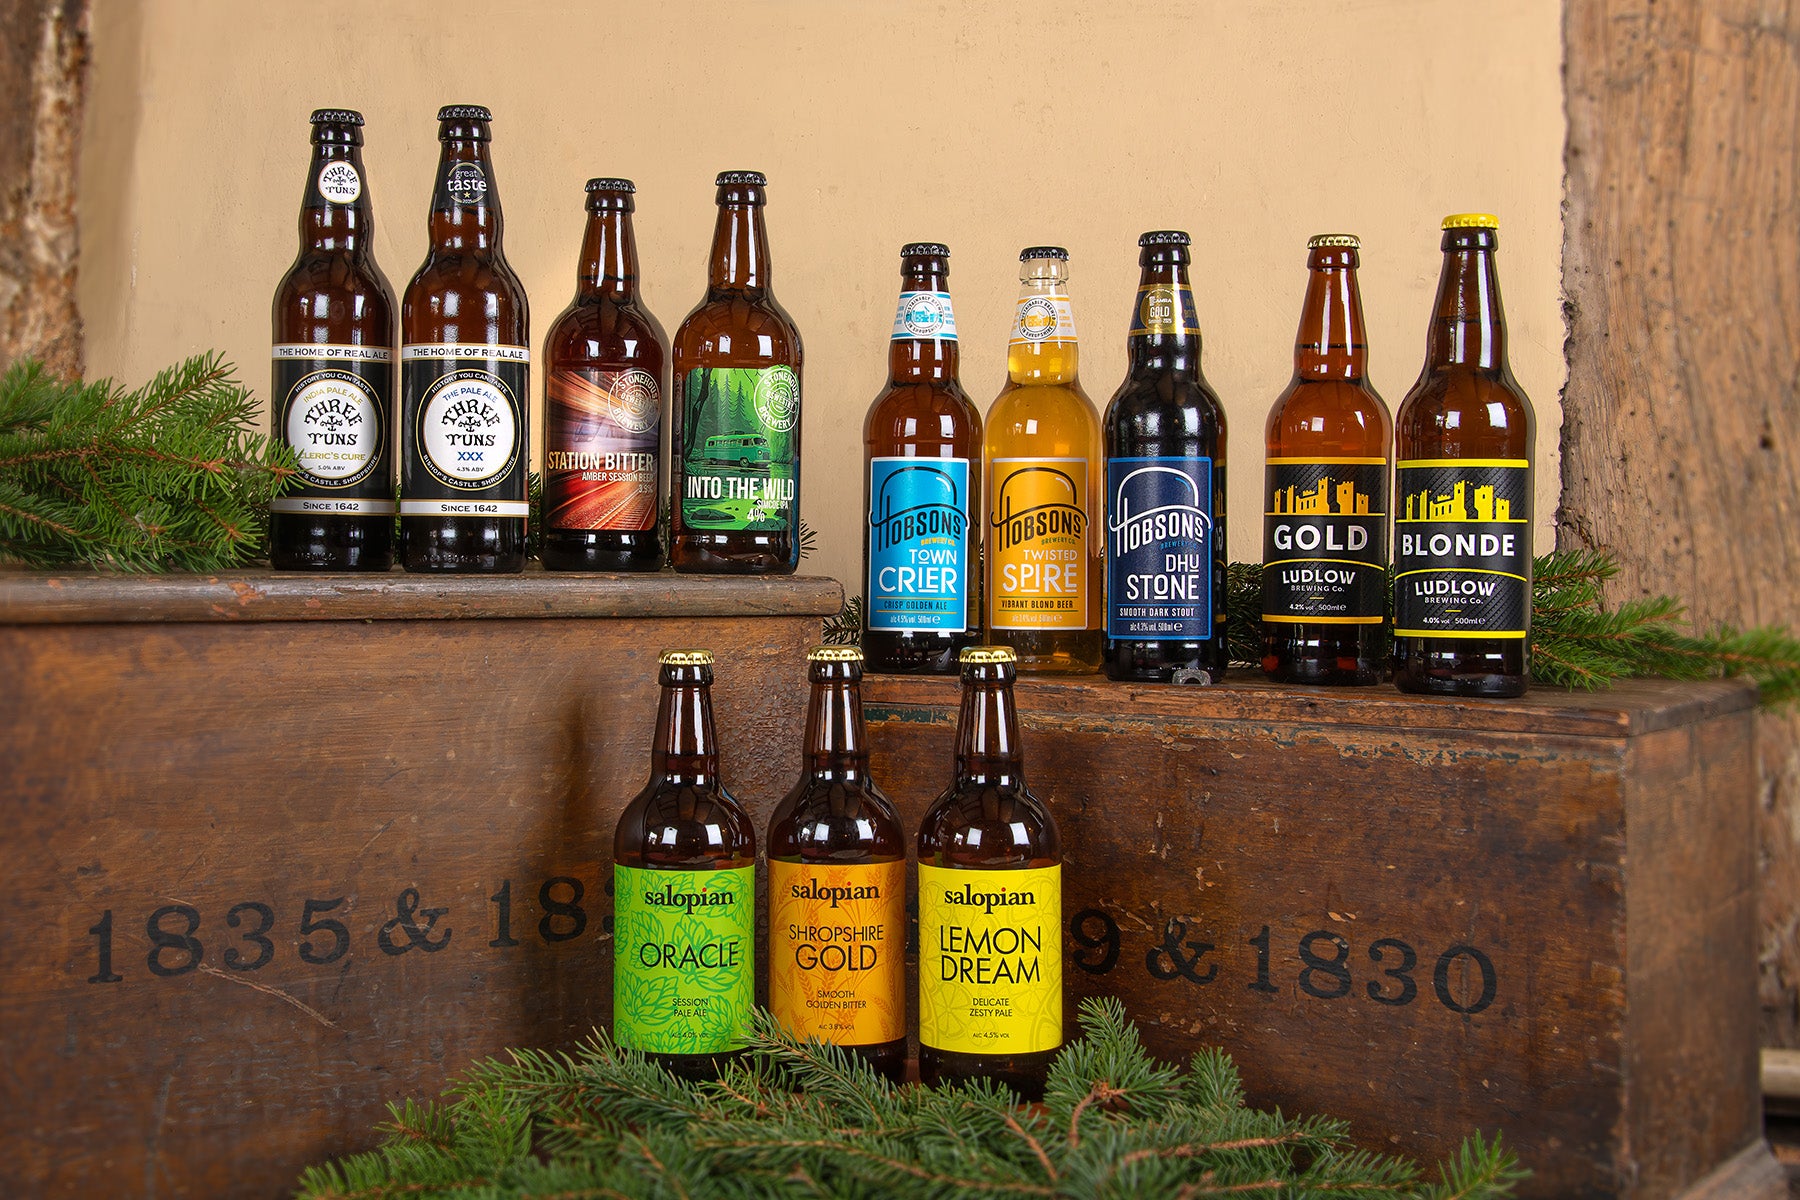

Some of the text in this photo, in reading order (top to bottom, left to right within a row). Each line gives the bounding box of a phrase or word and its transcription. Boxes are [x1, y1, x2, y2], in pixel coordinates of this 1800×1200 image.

[323, 166, 358, 184] THREE
[455, 170, 478, 180] great
[325, 186, 356, 195] TUNS
[447, 178, 487, 192] taste
[1150, 306, 1170, 317] GOLD
[279, 348, 388, 360] THE HOME OF REAL ALE
[413, 348, 523, 360] THE HOME OF REAL ALE
[295, 374, 321, 393] HISTORY
[337, 373, 354, 382] CAN
[353, 378, 371, 394] TASTE
[431, 373, 458, 394] HISTORY
[474, 373, 490, 382] CAN
[490, 378, 508, 395] TASTE
[618, 373, 659, 405] STONEHOUSE
[764, 371, 799, 402] STONEHOUSE
[303, 387, 364, 404] INDIA PALE ALE
[443, 387, 498, 404] THE PALE ALE
[304, 398, 363, 427] THREE
[441, 398, 501, 428] THREE
[613, 407, 650, 430] BREWERY
[759, 405, 791, 429] BREWERY
[308, 432, 359, 446] TUNS
[445, 433, 497, 447] TUNS
[340, 453, 366, 461] CURE
[457, 452, 484, 461] XXX
[548, 451, 654, 472] STATION BITTER
[342, 455, 378, 485] SHROPSHIRE
[423, 454, 447, 481] BISHOP'S
[481, 456, 516, 486] SHROPSHIRE
[582, 471, 654, 483] AMBER SESSION BEER
[687, 476, 794, 501] INTO THE WILD
[303, 501, 360, 511] SINCE 1642
[441, 504, 498, 512] SINCE 1642
[746, 508, 766, 523] 4%
[1274, 524, 1369, 551] GOLD
[1402, 533, 1516, 557] BLONDE
[908, 549, 958, 565] TOWN
[1023, 549, 1078, 561] TWISTED
[879, 566, 958, 594] CRIER
[1002, 563, 1078, 593] SPIRE
[1282, 569, 1356, 585] LUDLOW
[1126, 574, 1200, 601] STONE
[1415, 579, 1496, 597] LUDLOW
[884, 600, 948, 610] CRISP GOLDEN ALE
[1002, 600, 1073, 609] VIBRANT BLOND BEER
[1289, 603, 1304, 611] 4.2%
[1424, 596, 1467, 604] BREWING
[1119, 608, 1195, 618] SMOOTH DARK STOUT
[1423, 616, 1440, 624] 4.0%
[1454, 617, 1478, 625] 500ml
[644, 885, 734, 915] salopian
[791, 878, 881, 909] salopian
[944, 883, 1036, 915] salopian
[87, 896, 352, 985] 1835
[377, 887, 453, 957] &
[789, 924, 884, 943] SHROPSHIRE
[940, 925, 1042, 955] LEMON
[639, 941, 739, 969] ORACLE
[795, 943, 878, 972] GOLD
[941, 954, 1041, 985] DREAM
[1145, 917, 1218, 985] &
[1246, 925, 1497, 1014] 1830
[672, 997, 709, 1007] SESSION
[817, 990, 856, 999] SMOOTH
[972, 998, 1010, 1007] DELICATE
[673, 1008, 707, 1018] PALE ALE
[805, 1000, 867, 1010] GOLDEN BITTER
[969, 1008, 1013, 1018] ZESTY PALE
[983, 1031, 1000, 1039] 4.5%
